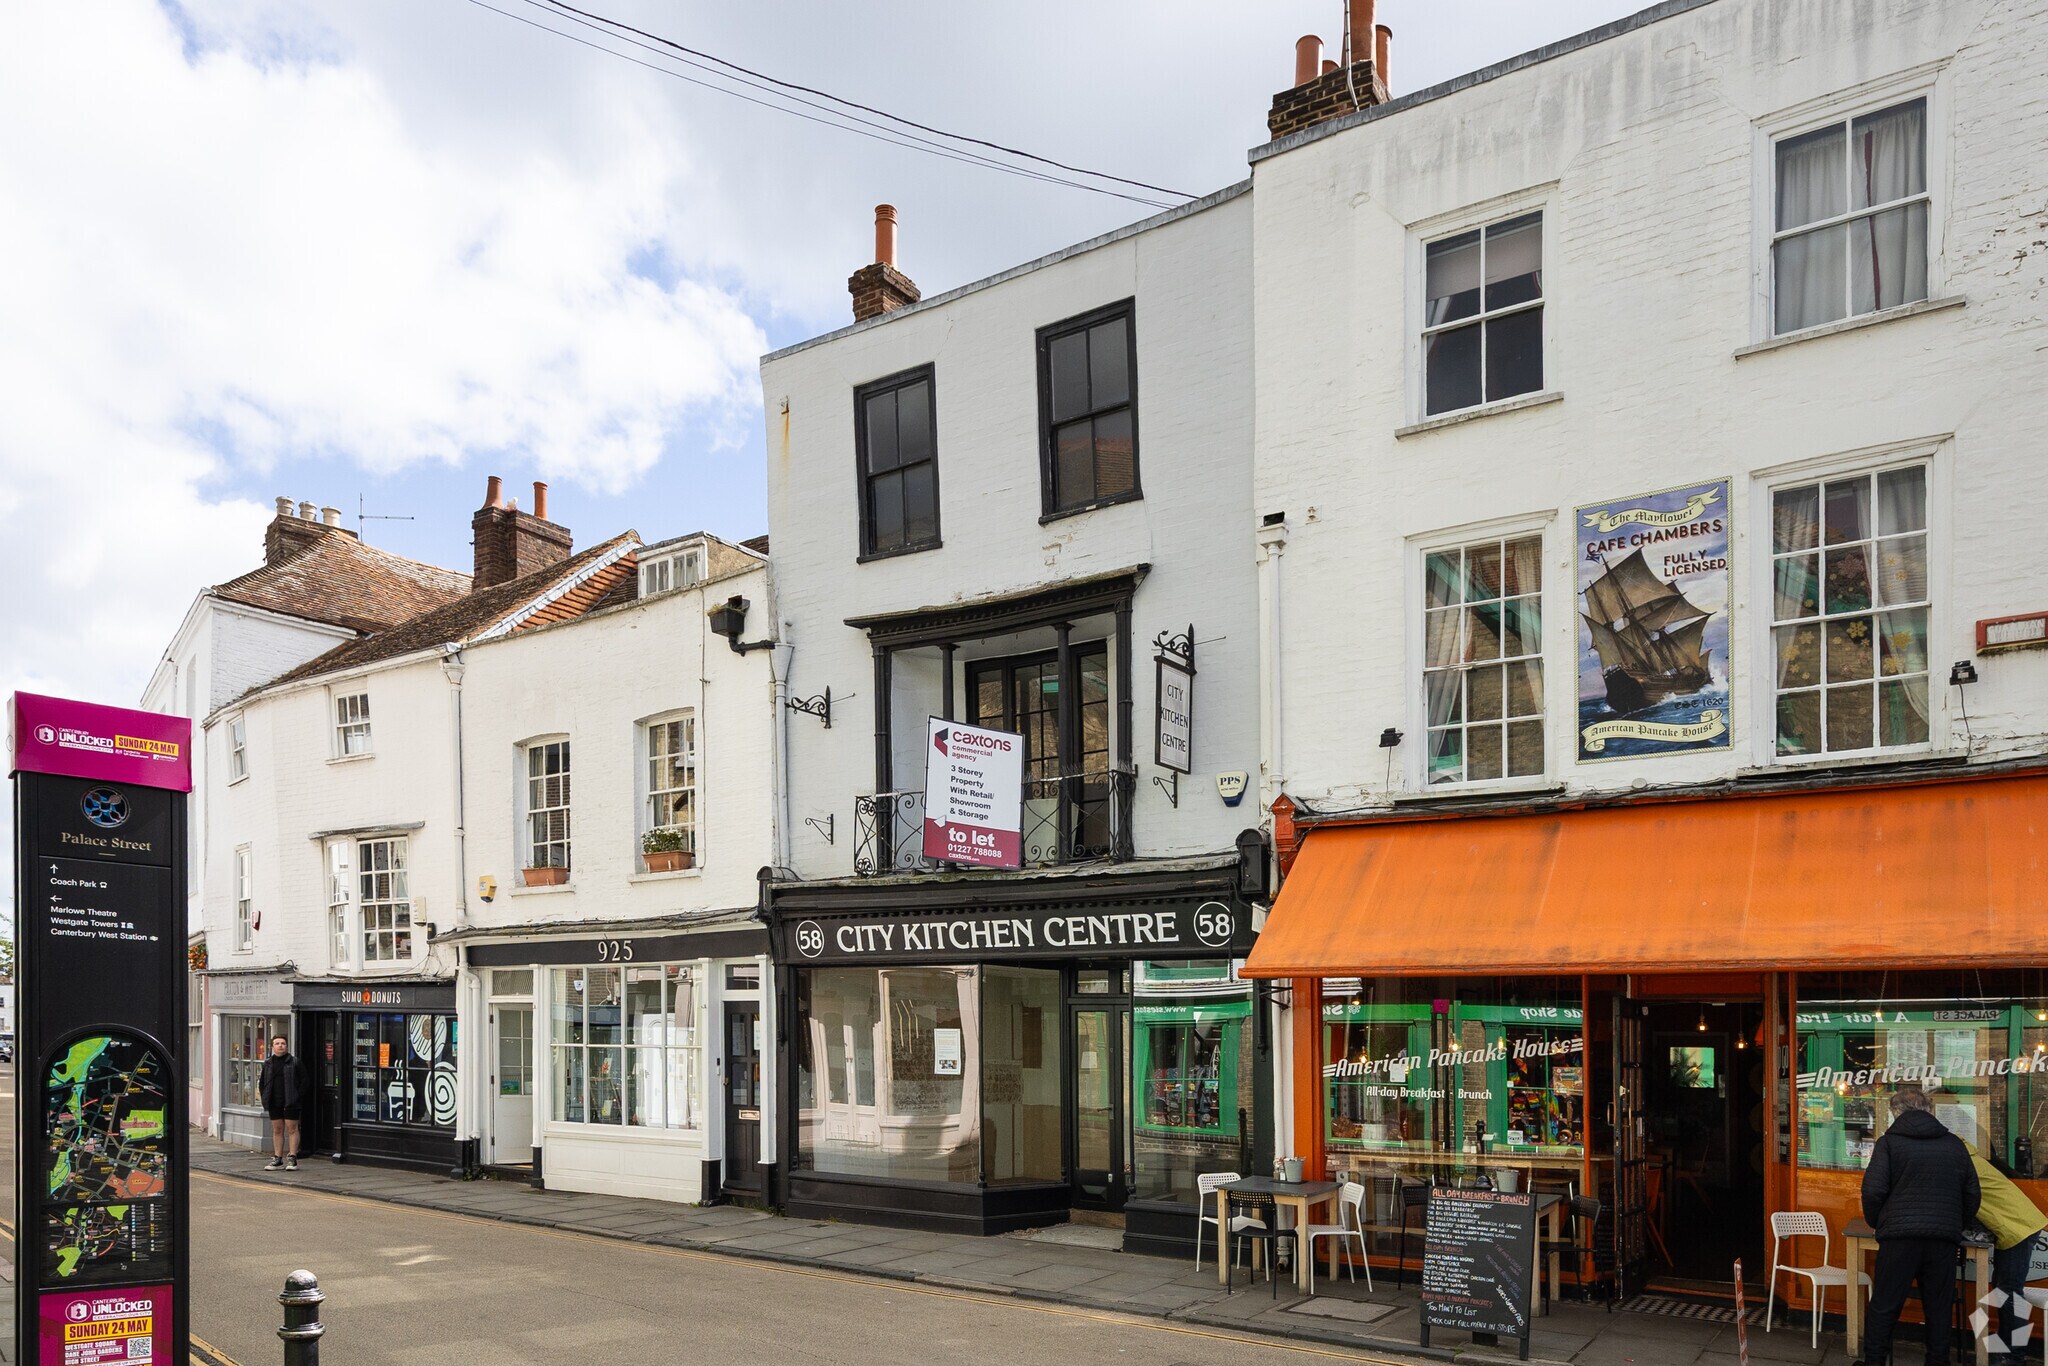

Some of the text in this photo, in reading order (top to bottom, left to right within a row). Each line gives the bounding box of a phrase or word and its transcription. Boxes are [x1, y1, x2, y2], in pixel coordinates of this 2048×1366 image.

[1610, 508, 1694, 527] The Mayflower
[1586, 519, 1723, 554] CAFE CHAMBERS
[1664, 549, 1708, 566] FULLY
[1664, 558, 1727, 577] LICENSED
[1167, 684, 1184, 701] CITY
[1702, 698, 1724, 706] 1620
[1161, 706, 1189, 729] KITCHEN
[1591, 722, 1714, 738] American Pancake House
[59, 733, 114, 748] UNLOCKED
[118, 737, 176, 754] SUNDAY 24 MAY
[952, 731, 1012, 752] caxtons
[1162, 733, 1187, 753] CENTRE
[952, 745, 992, 756] commercial
[952, 752, 976, 762] agency
[958, 766, 984, 778] Storey
[951, 776, 984, 788] Property
[1220, 776, 1240, 785] PPS
[950, 786, 968, 795] With
[950, 797, 991, 810] Showroom
[958, 809, 989, 820] Storage
[61, 832, 152, 852] Palace Street
[949, 827, 995, 847] to let
[948, 844, 1002, 858] 01227 788088
[50, 878, 97, 888] Coach Park
[50, 906, 117, 917] Marlowe Theatre
[50, 917, 118, 928] Westgate Towers
[50, 928, 147, 941] Canterbury West Station
[800, 912, 1230, 953] 58 CITY KITCHEN CENTRE 58
[598, 940, 633, 962] 925
[342, 991, 401, 1004] SUMO DONUTS
[1336, 1038, 1572, 1077] American Pancake House
[1815, 1062, 1936, 1088] American
[1945, 1049, 2048, 1079] Pancak
[1366, 1086, 1398, 1099] All-day
[1400, 1087, 1445, 1101] Breakfast
[1458, 1089, 1492, 1100] Brunch
[1432, 1188, 1446, 1197] ALL
[1446, 1189, 1460, 1198] DAY
[1462, 1192, 1497, 1200] BREAKFAST
[1500, 1194, 1530, 1205] BRUNCH
[92, 1300, 152, 1315] UNLOCKED
[1427, 1302, 1478, 1316] TOO MANY TO LIST
[70, 1319, 148, 1338] SUNDAY 24 MAY
[1428, 1316, 1444, 1324] CHECK
[1498, 1323, 1516, 1333] STORE
[95, 1340, 116, 1348] SQUARE
[97, 1346, 123, 1354] GARDENS
